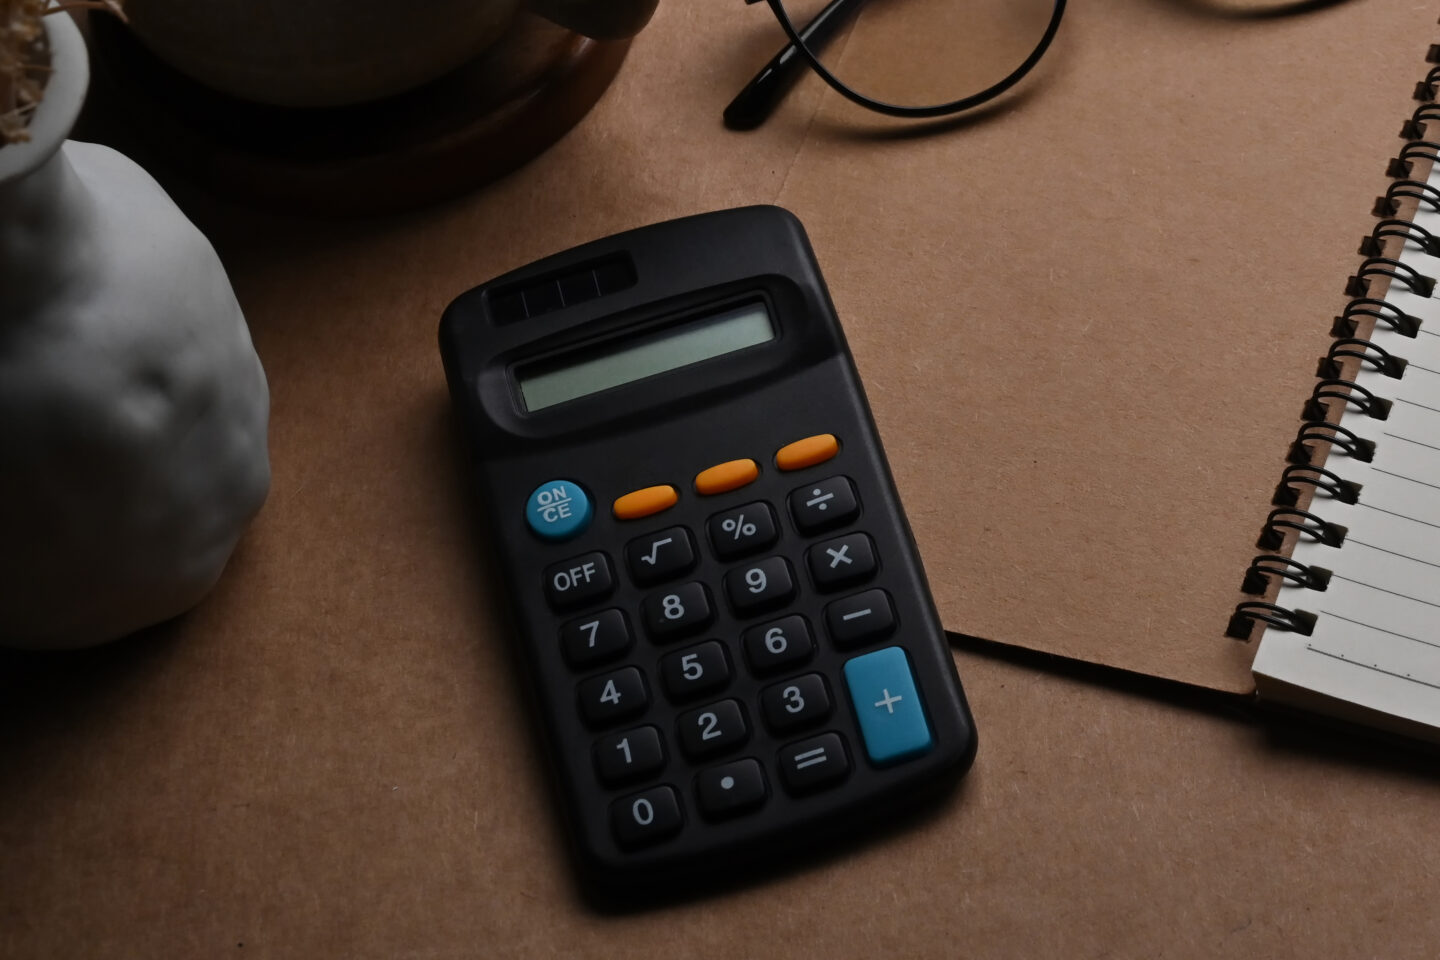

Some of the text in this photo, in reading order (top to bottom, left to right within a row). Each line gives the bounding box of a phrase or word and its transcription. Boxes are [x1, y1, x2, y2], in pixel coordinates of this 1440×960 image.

[537, 485, 567, 506] ON
[542, 502, 571, 524] CE
[721, 514, 757, 540] %
[553, 561, 596, 591] OFF
[745, 567, 767, 594] 9
[662, 594, 685, 620] 8
[579, 620, 600, 648] 7
[765, 627, 788, 654] 6
[681, 653, 704, 680] 5
[599, 679, 622, 705] 4
[782, 685, 805, 713] 3
[697, 712, 721, 740] 2
[616, 737, 632, 764] 1
[632, 798, 654, 825] 0
